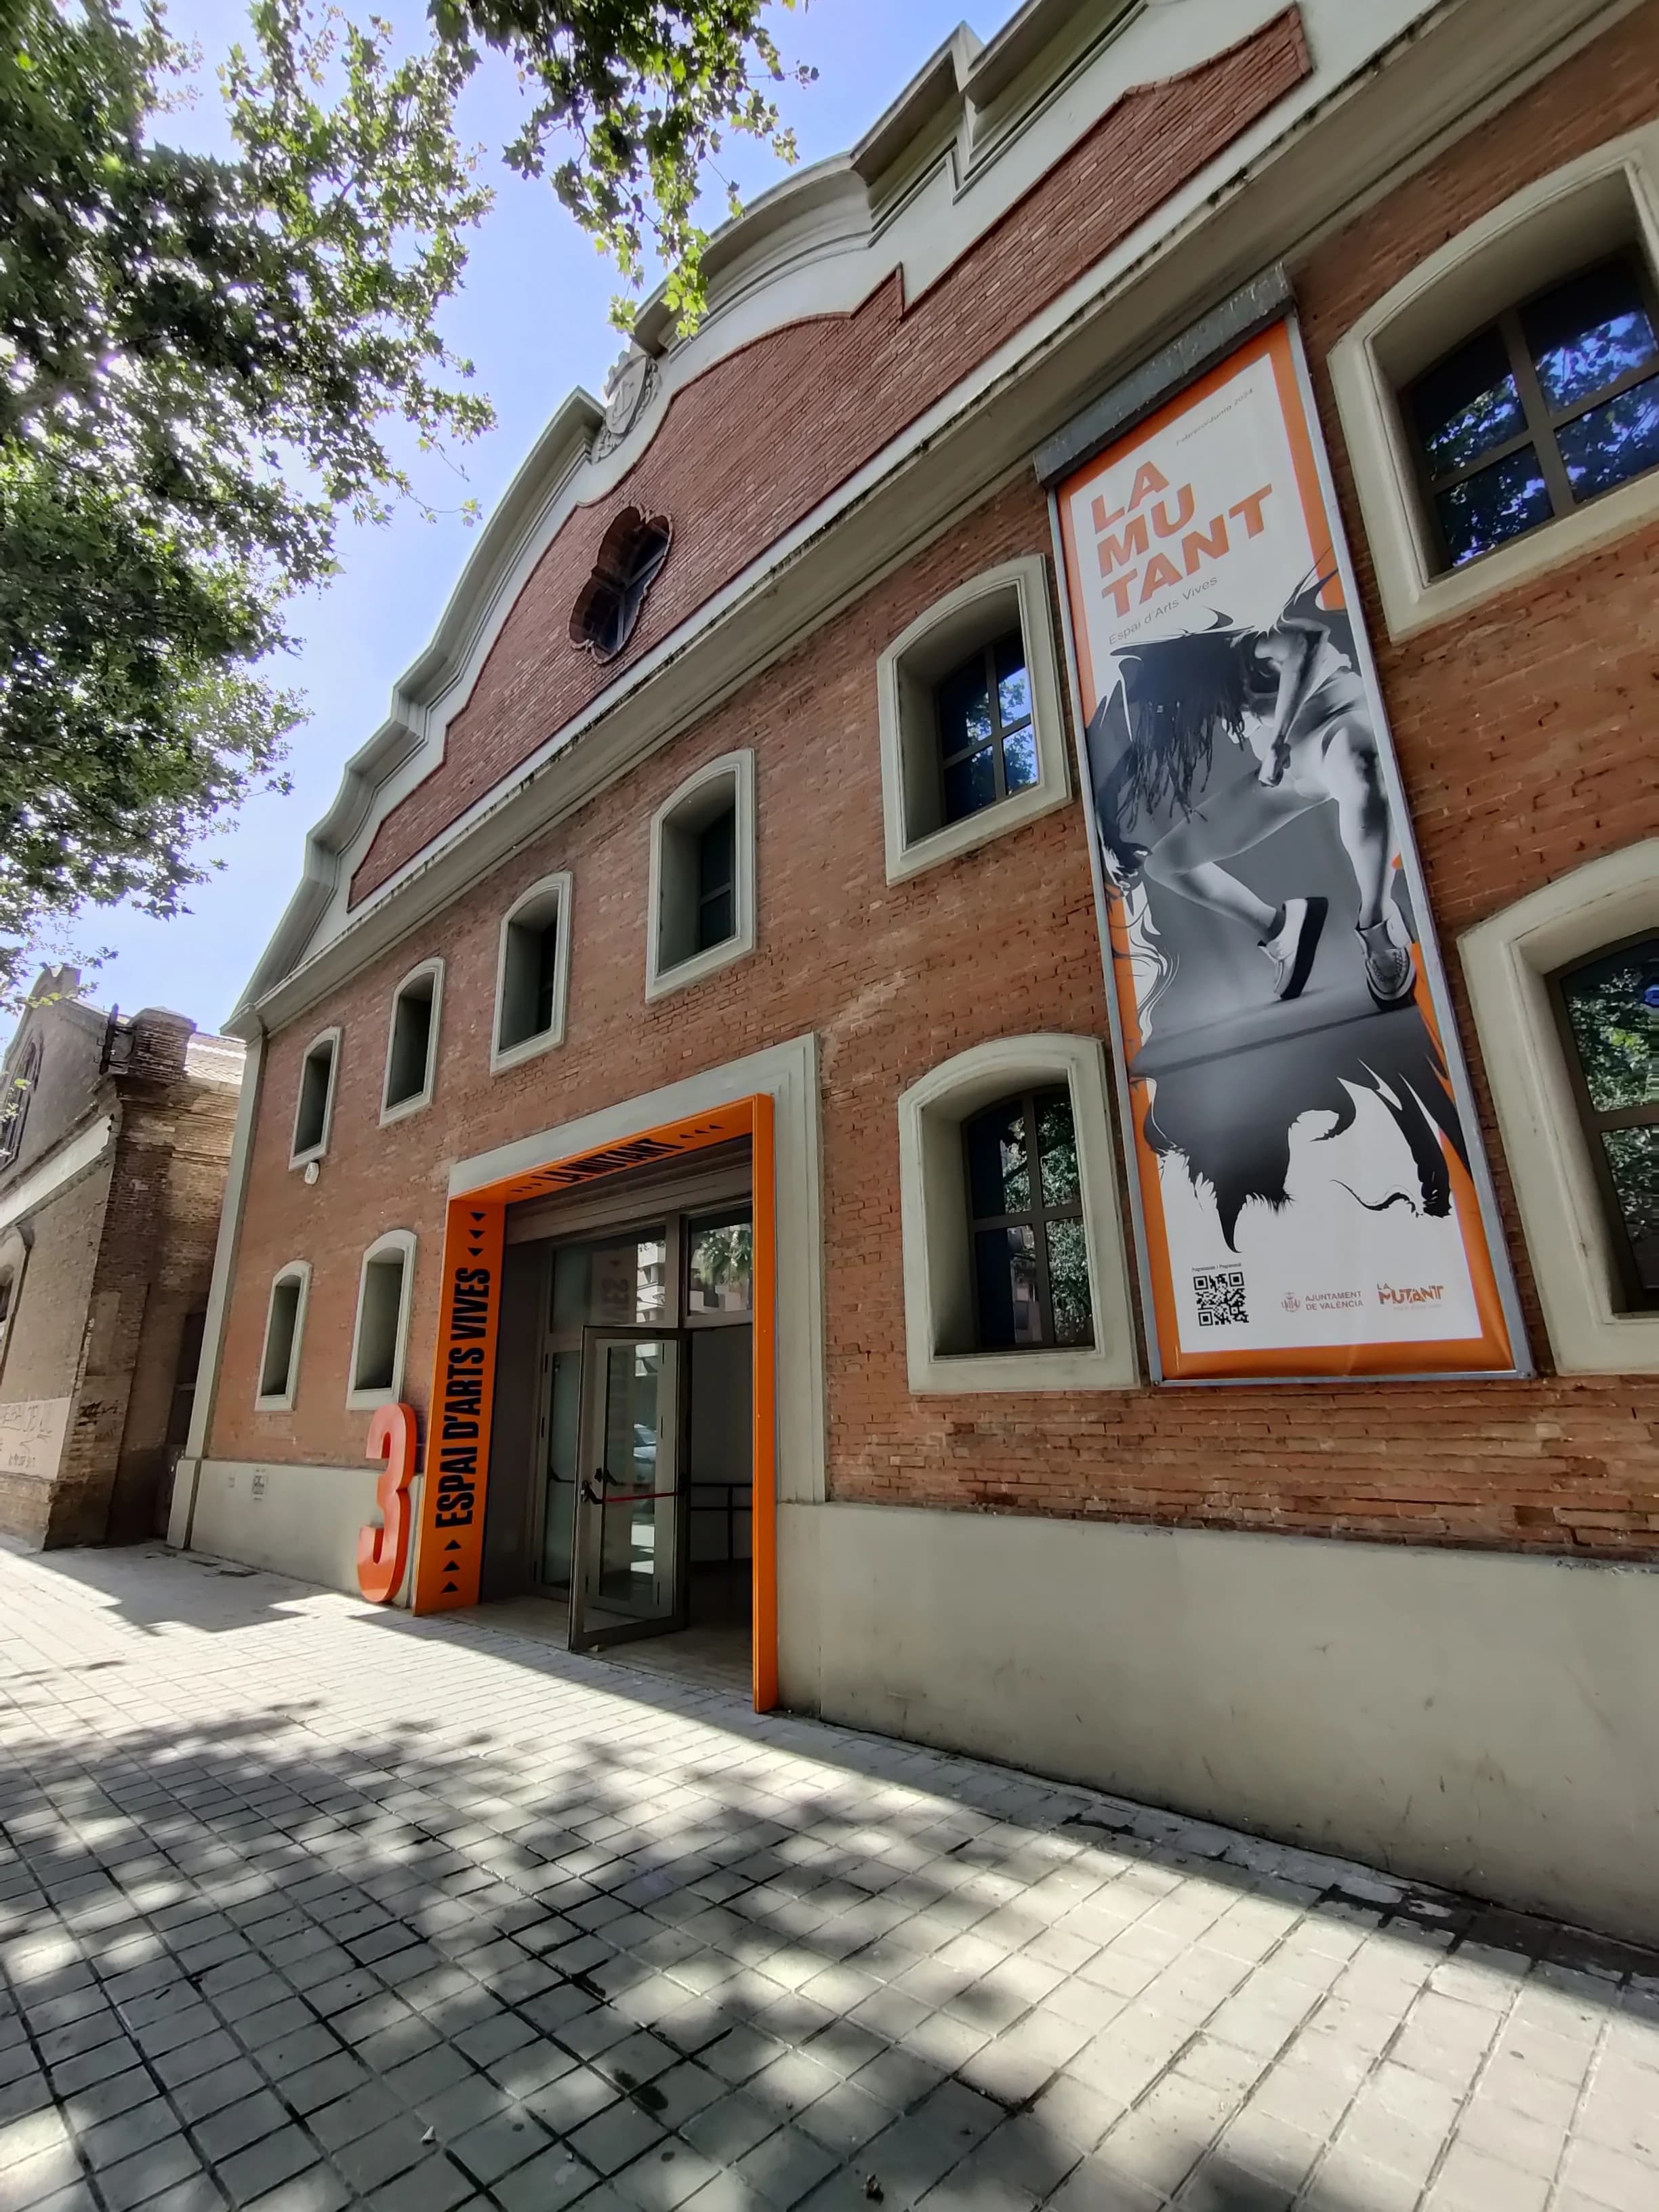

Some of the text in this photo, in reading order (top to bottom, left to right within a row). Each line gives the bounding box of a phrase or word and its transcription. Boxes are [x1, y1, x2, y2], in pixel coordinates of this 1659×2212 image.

[1091, 461, 1170, 535] LA
[1097, 483, 1195, 578] MU
[1101, 483, 1272, 618] TANT
[1109, 576, 1218, 645] Espai d'Arts Vives
[1305, 1290, 1361, 1302] AJUNTAMENT
[1306, 1303, 1317, 1311] DE
[1378, 1285, 1443, 1305] MUTANT
[435, 1267, 490, 1528] ESPAI D'ARTS VIVES
[357, 1402, 417, 1602] 3
